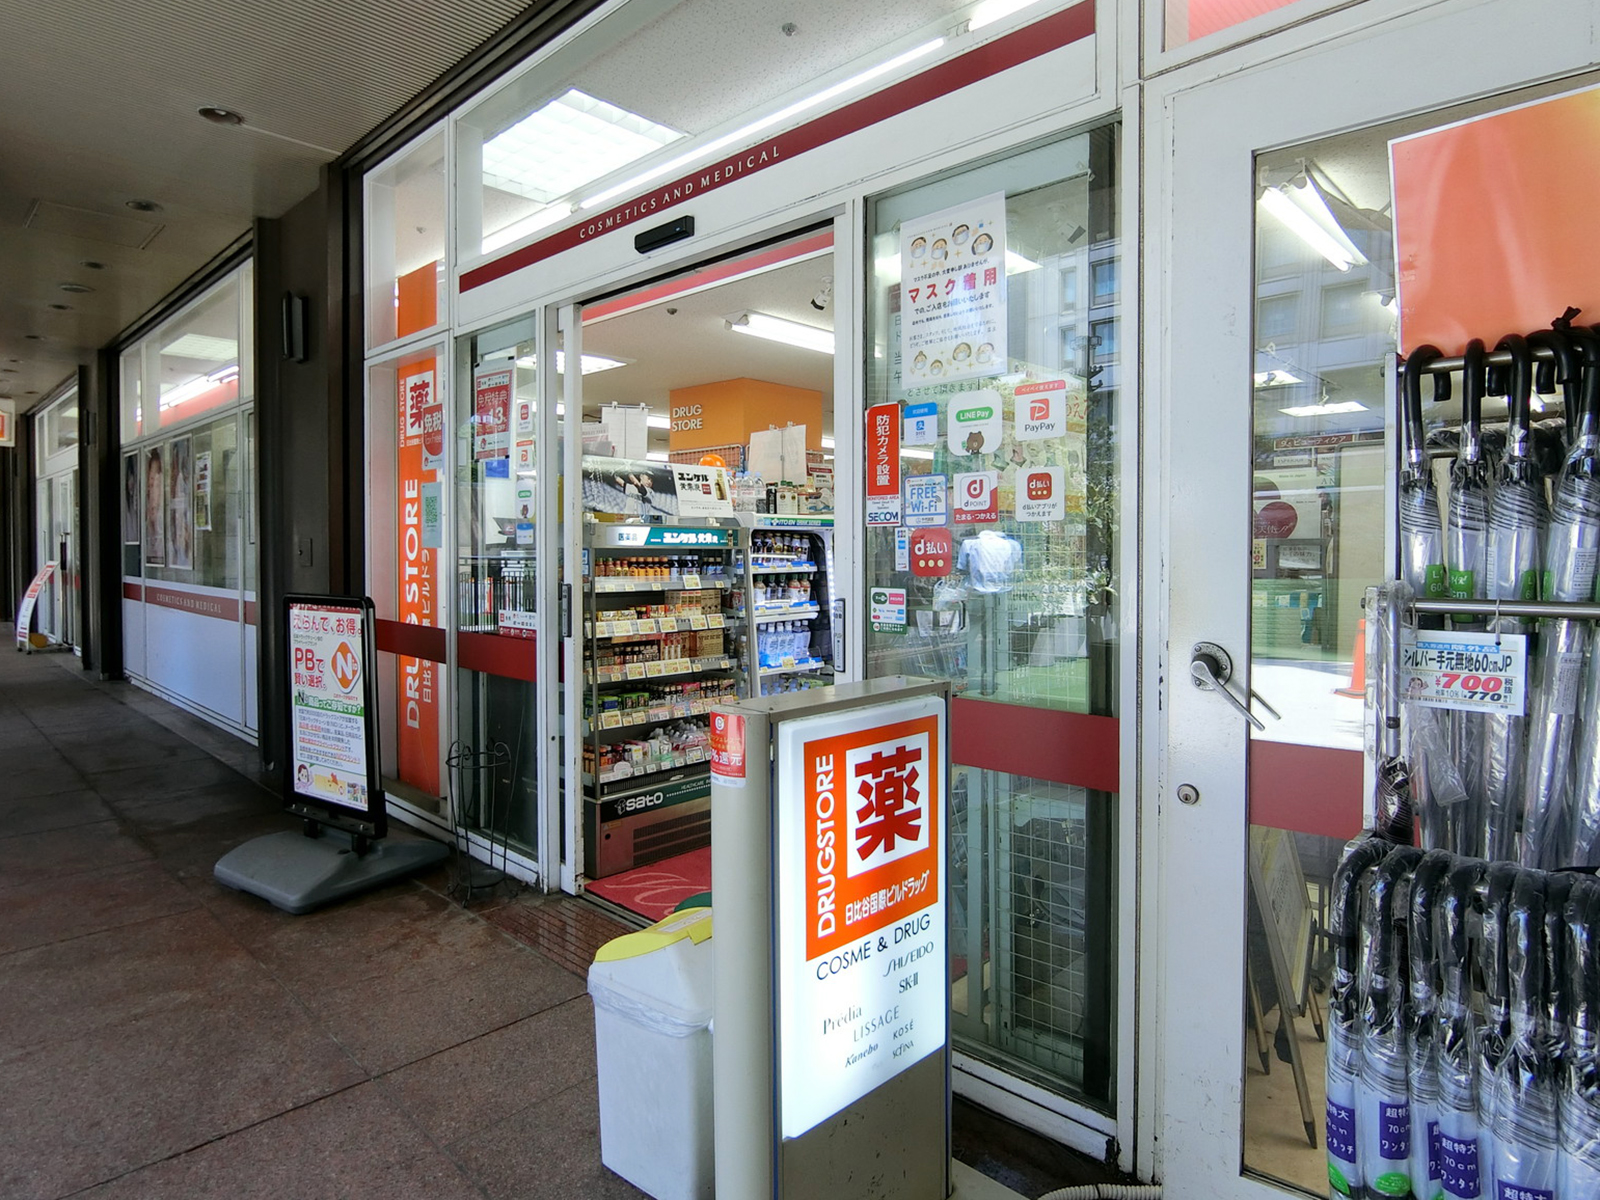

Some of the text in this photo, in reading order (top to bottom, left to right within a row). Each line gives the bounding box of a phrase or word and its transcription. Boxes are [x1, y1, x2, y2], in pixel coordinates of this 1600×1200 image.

[579, 146, 781, 239] COSMETICS AND MEDICAL
[908, 267, 997, 303] マスク着用
[672, 404, 702, 418] DRUG
[960, 410, 990, 420] LINE Pay
[424, 411, 442, 434] 免税
[672, 418, 703, 432] STORE
[1025, 422, 1056, 432] PayPay
[876, 414, 890, 486] 防犯カメラ設置
[677, 472, 710, 482] ユンケル
[1029, 480, 1050, 489] d払い
[910, 486, 937, 499] FREE
[910, 500, 937, 512] Wi-Fi
[1022, 502, 1058, 510] d払いアプリが
[868, 512, 899, 522] SECOM
[955, 512, 996, 521] たまる・つかえる
[406, 478, 419, 604] STORE
[914, 539, 948, 556] d払い
[1451, 644, 1498, 653] 除外品
[294, 647, 324, 673] PBで
[1404, 649, 1512, 673] シルバー手元無地60cmJP
[1435, 672, 1503, 692] ¥700
[1504, 678, 1513, 694] 税抜
[626, 792, 664, 812] sato
[854, 745, 924, 862] 薬
[815, 753, 836, 938] DRUGSTORE
[844, 868, 930, 926] 日比谷国際ビルドラッグ
[816, 913, 930, 981] COSME & DRUG
[883, 941, 934, 978] SHISEIDO
[854, 1006, 900, 1042] LISSAGE
[893, 1019, 914, 1040] KOSÉ
[844, 1043, 879, 1068] Kanebo
[1381, 1140, 1410, 1152] ワンタ
[1442, 1137, 1477, 1155] 超特大
